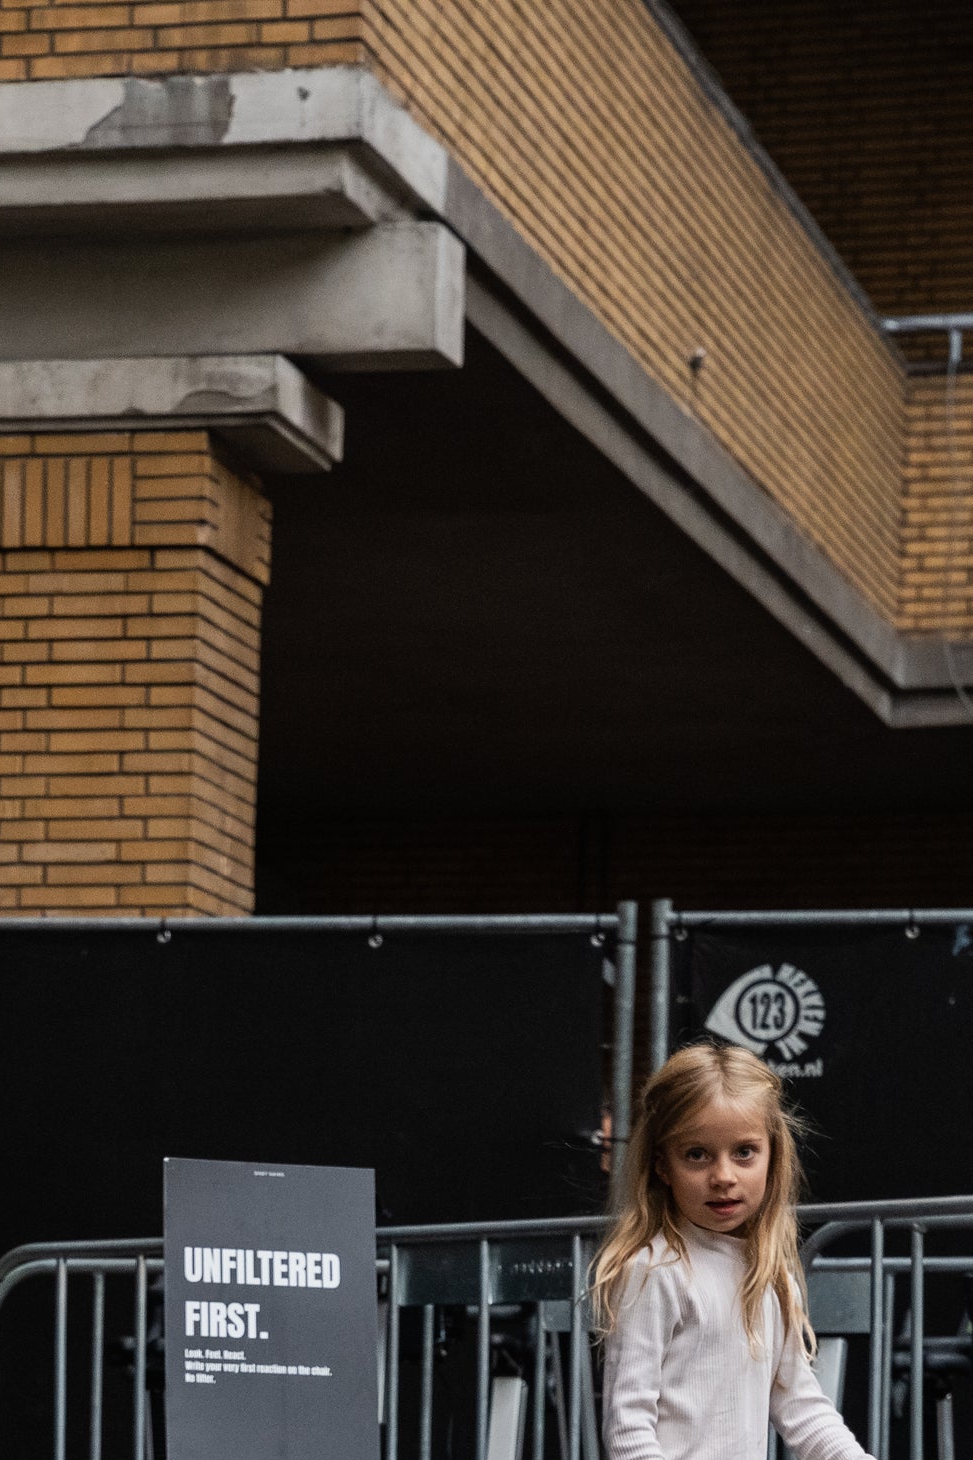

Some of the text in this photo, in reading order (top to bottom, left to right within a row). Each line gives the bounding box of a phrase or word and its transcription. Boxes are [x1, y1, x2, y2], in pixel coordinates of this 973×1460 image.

[750, 992, 786, 1030] 123
[184, 1246, 341, 1289] UNFILTERED
[185, 1300, 269, 1339] FIRST.
